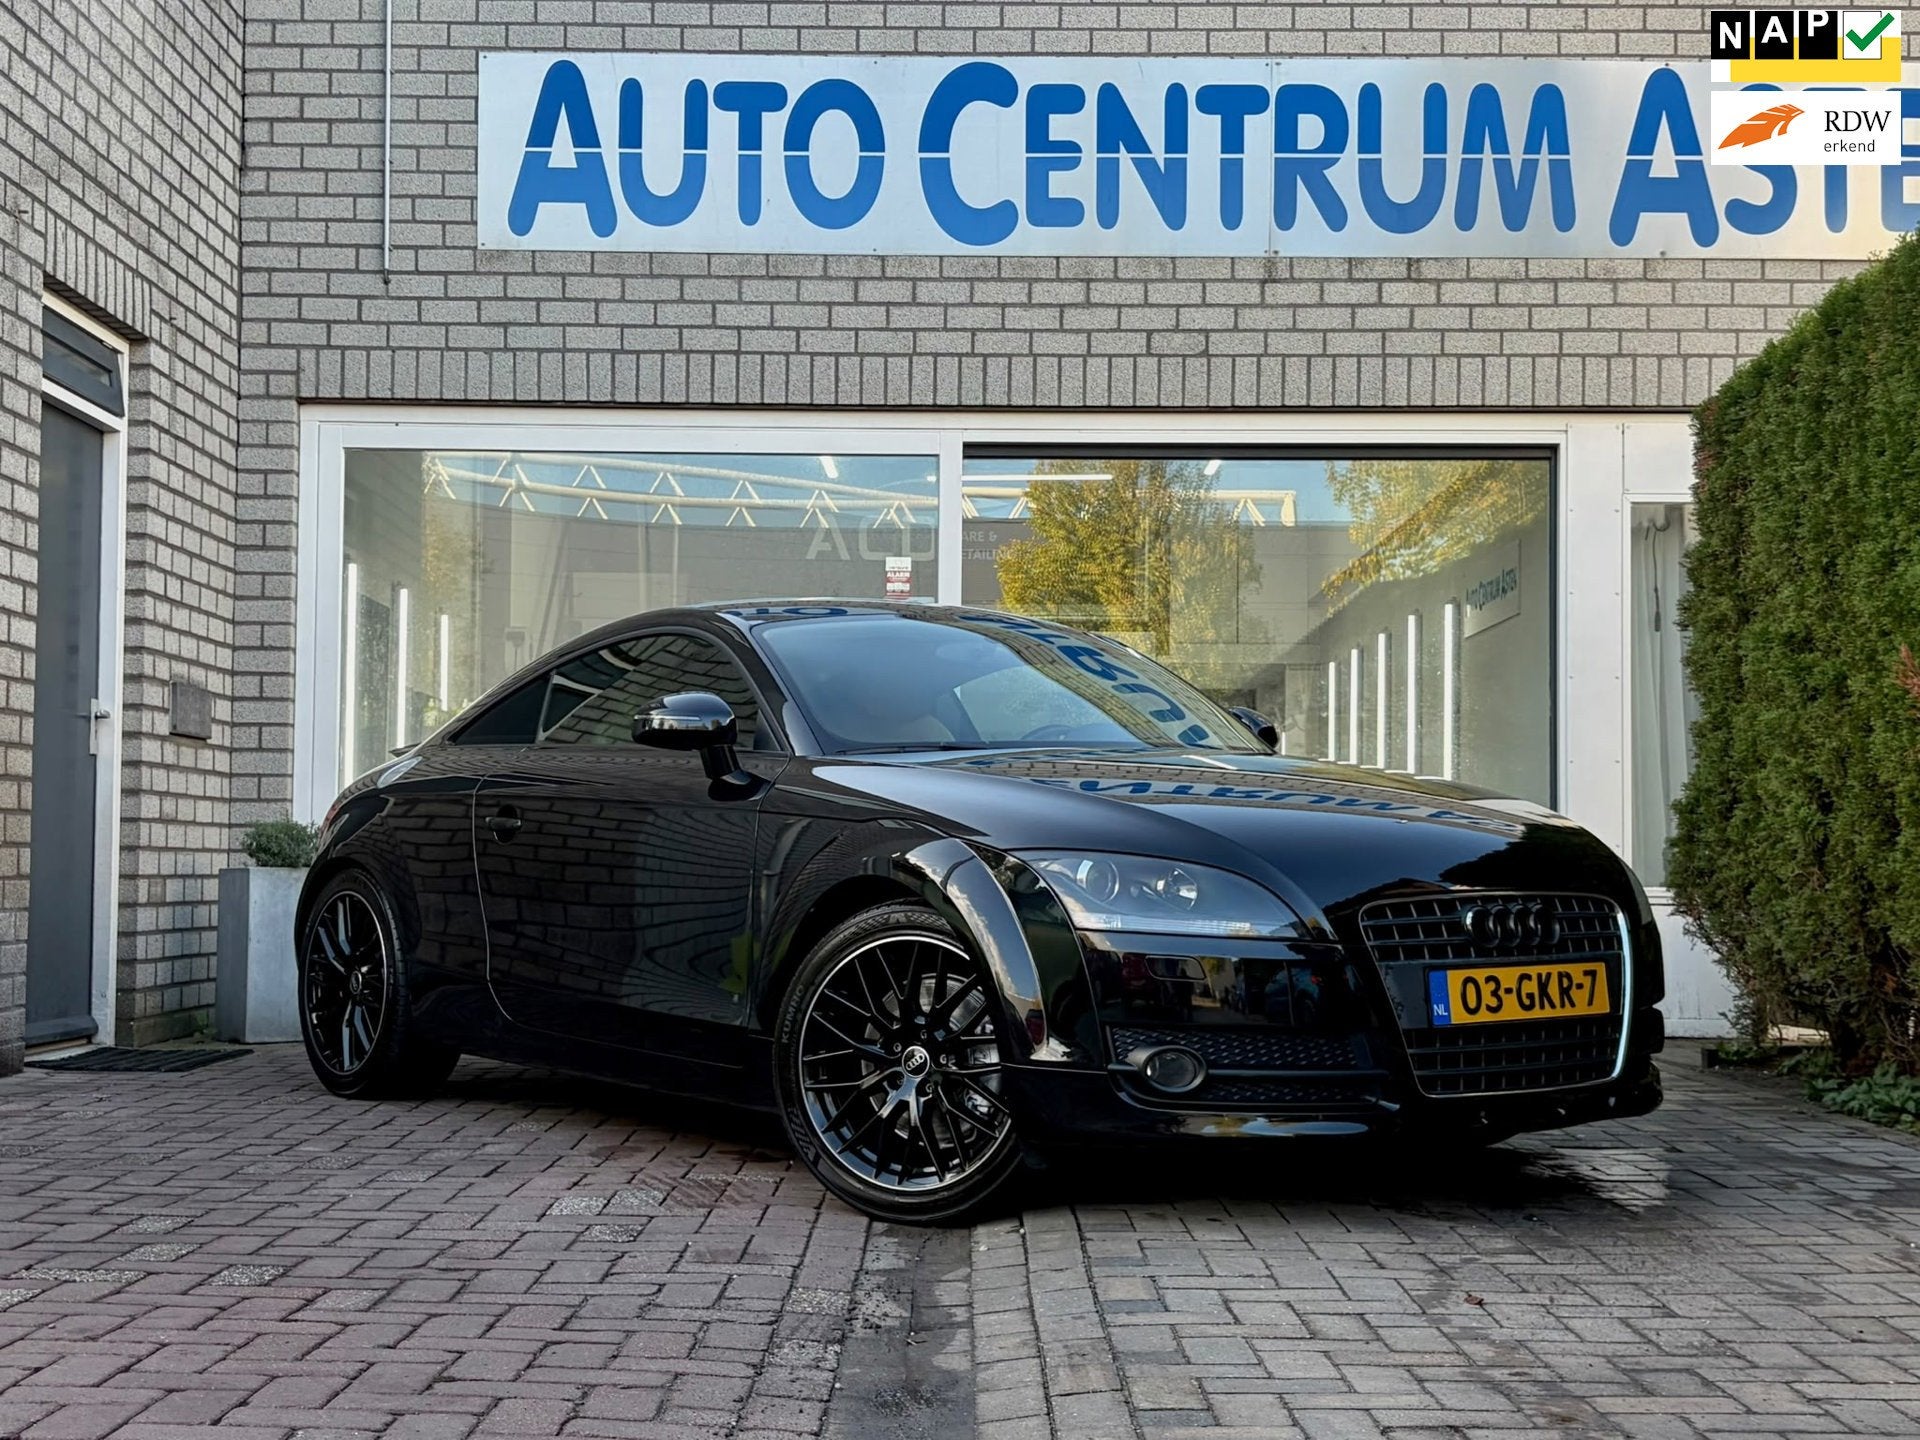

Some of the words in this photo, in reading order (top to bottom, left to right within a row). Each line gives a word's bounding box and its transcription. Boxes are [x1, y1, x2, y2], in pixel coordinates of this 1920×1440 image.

[507, 59, 886, 239] AUTO
[918, 61, 1577, 247] CENTRUM
[962, 531, 985, 542] ARE
[781, 984, 804, 1044] KUMHO
[1433, 1004, 1448, 1016] NL
[1460, 969, 1598, 1016] 03-GKR-7
